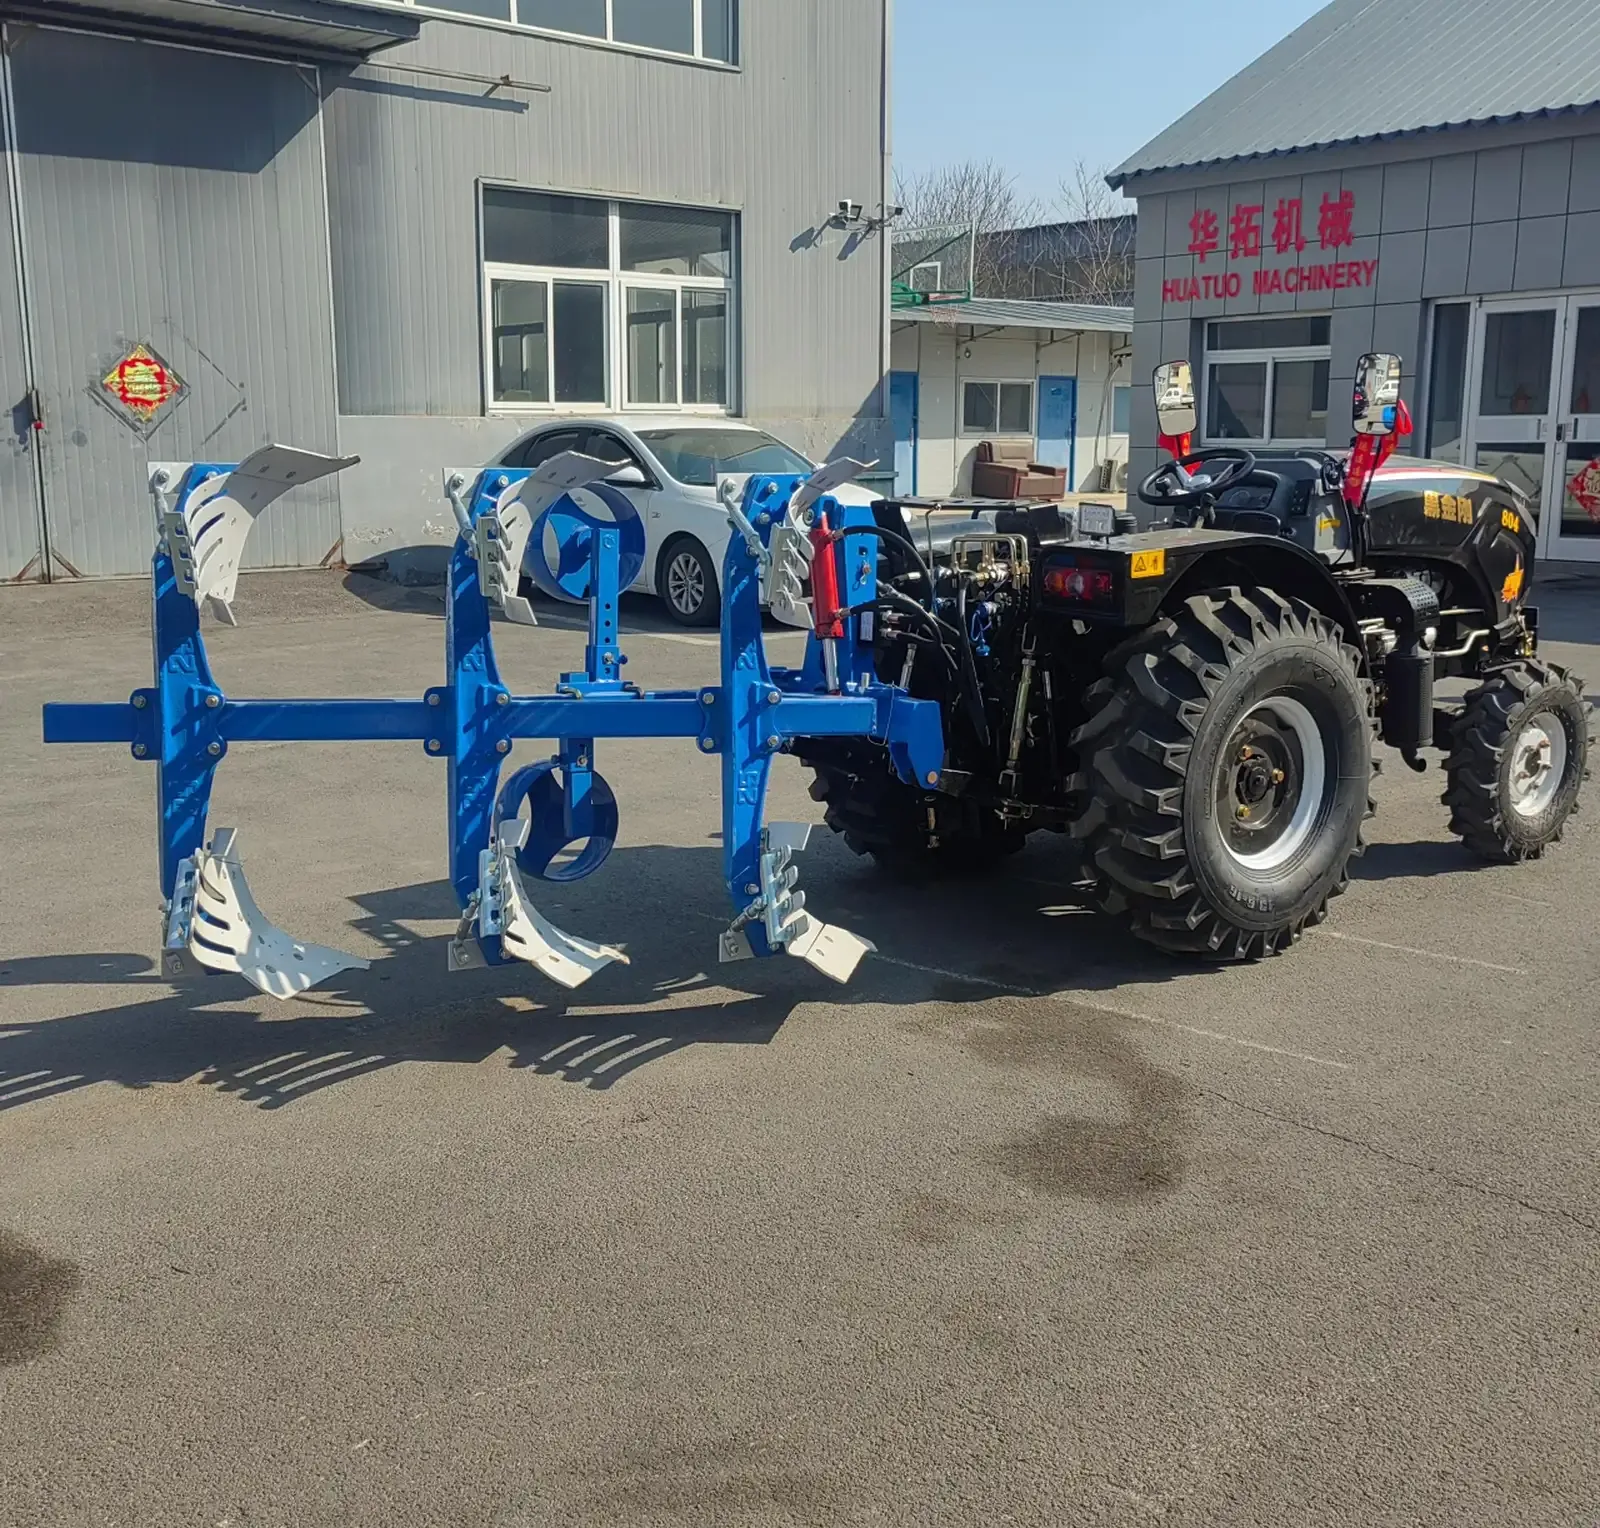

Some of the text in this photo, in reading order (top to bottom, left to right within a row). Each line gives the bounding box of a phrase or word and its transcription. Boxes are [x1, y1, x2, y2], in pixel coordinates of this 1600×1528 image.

[1188, 189, 1355, 264] 华拓机械
[1162, 259, 1379, 303] HUATUO MACHINERY
[1501, 509, 1520, 533] 804
